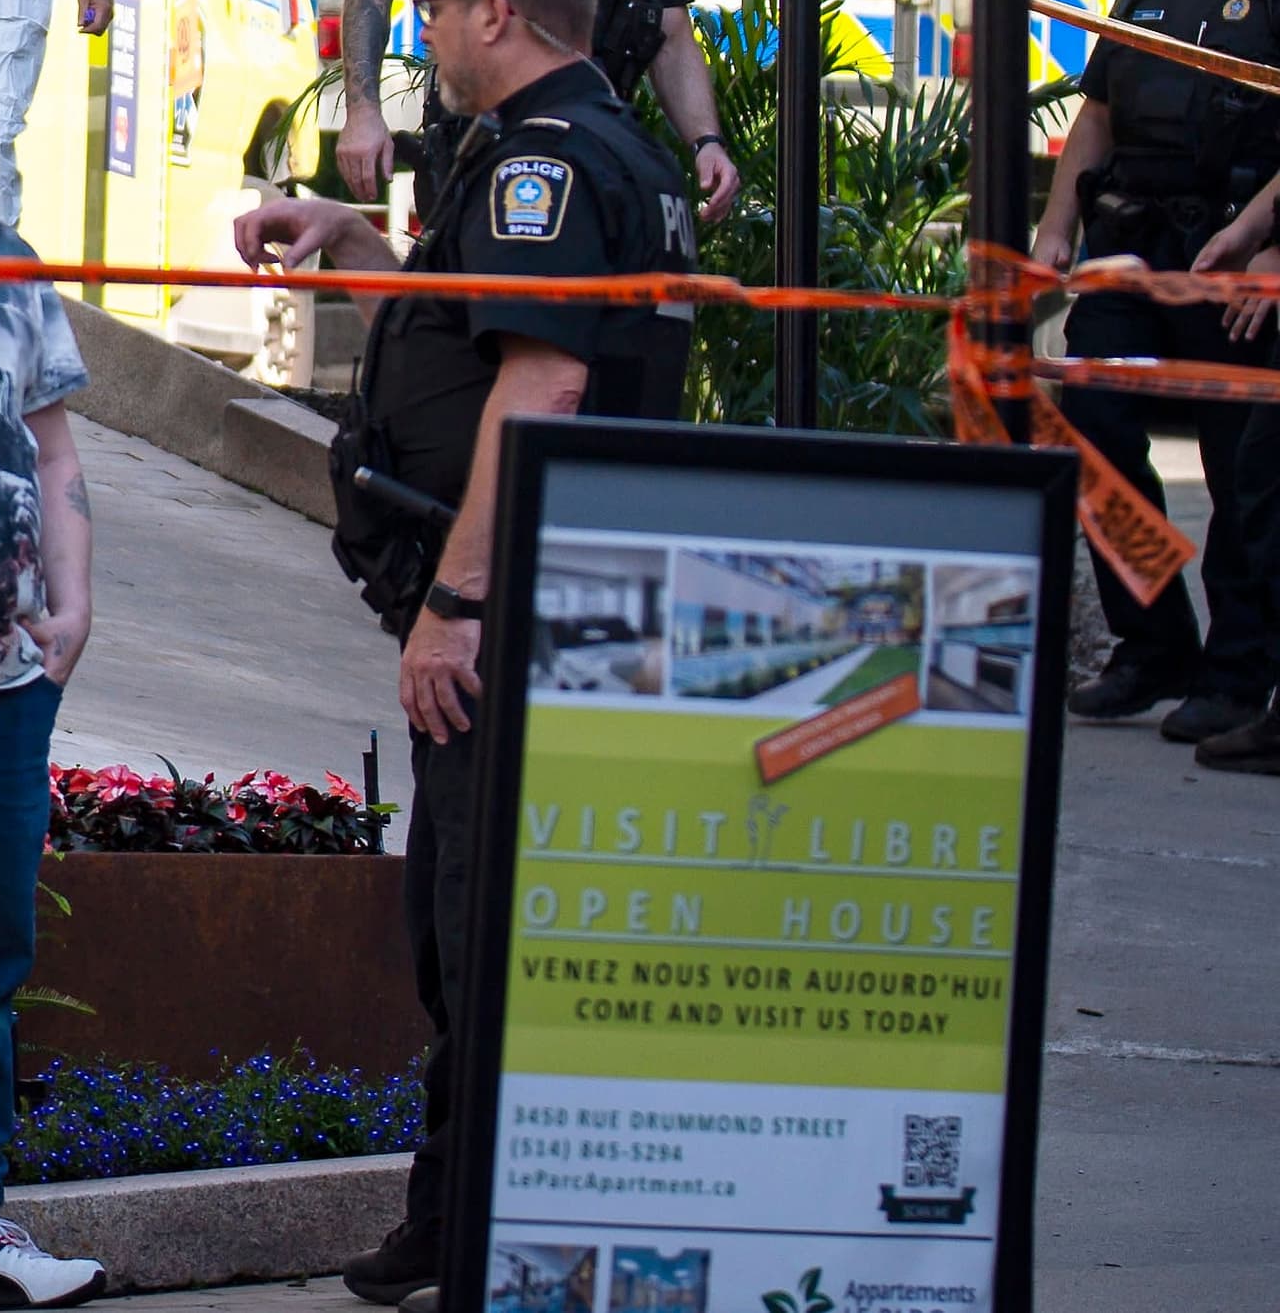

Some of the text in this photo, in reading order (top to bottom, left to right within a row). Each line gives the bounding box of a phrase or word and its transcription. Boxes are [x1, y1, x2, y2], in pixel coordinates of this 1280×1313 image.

[499, 161, 565, 181] POLICE
[658, 193, 697, 259] PO
[525, 803, 1003, 871] VISIT LIBRE
[524, 885, 996, 947] OPEN HOUSE
[523, 956, 619, 984] VENEZ
[632, 961, 710, 988] NOUS
[724, 964, 792, 991] VOIR
[575, 997, 950, 1035] COME AND VISIT US TODAY
[577, 1108, 620, 1130] RUE
[629, 1110, 763, 1136] DRUMMOND
[772, 1116, 848, 1137] STREET
[507, 1169, 737, 1198] LeParcApartment.ca
[844, 1281, 978, 1306] Appartements
